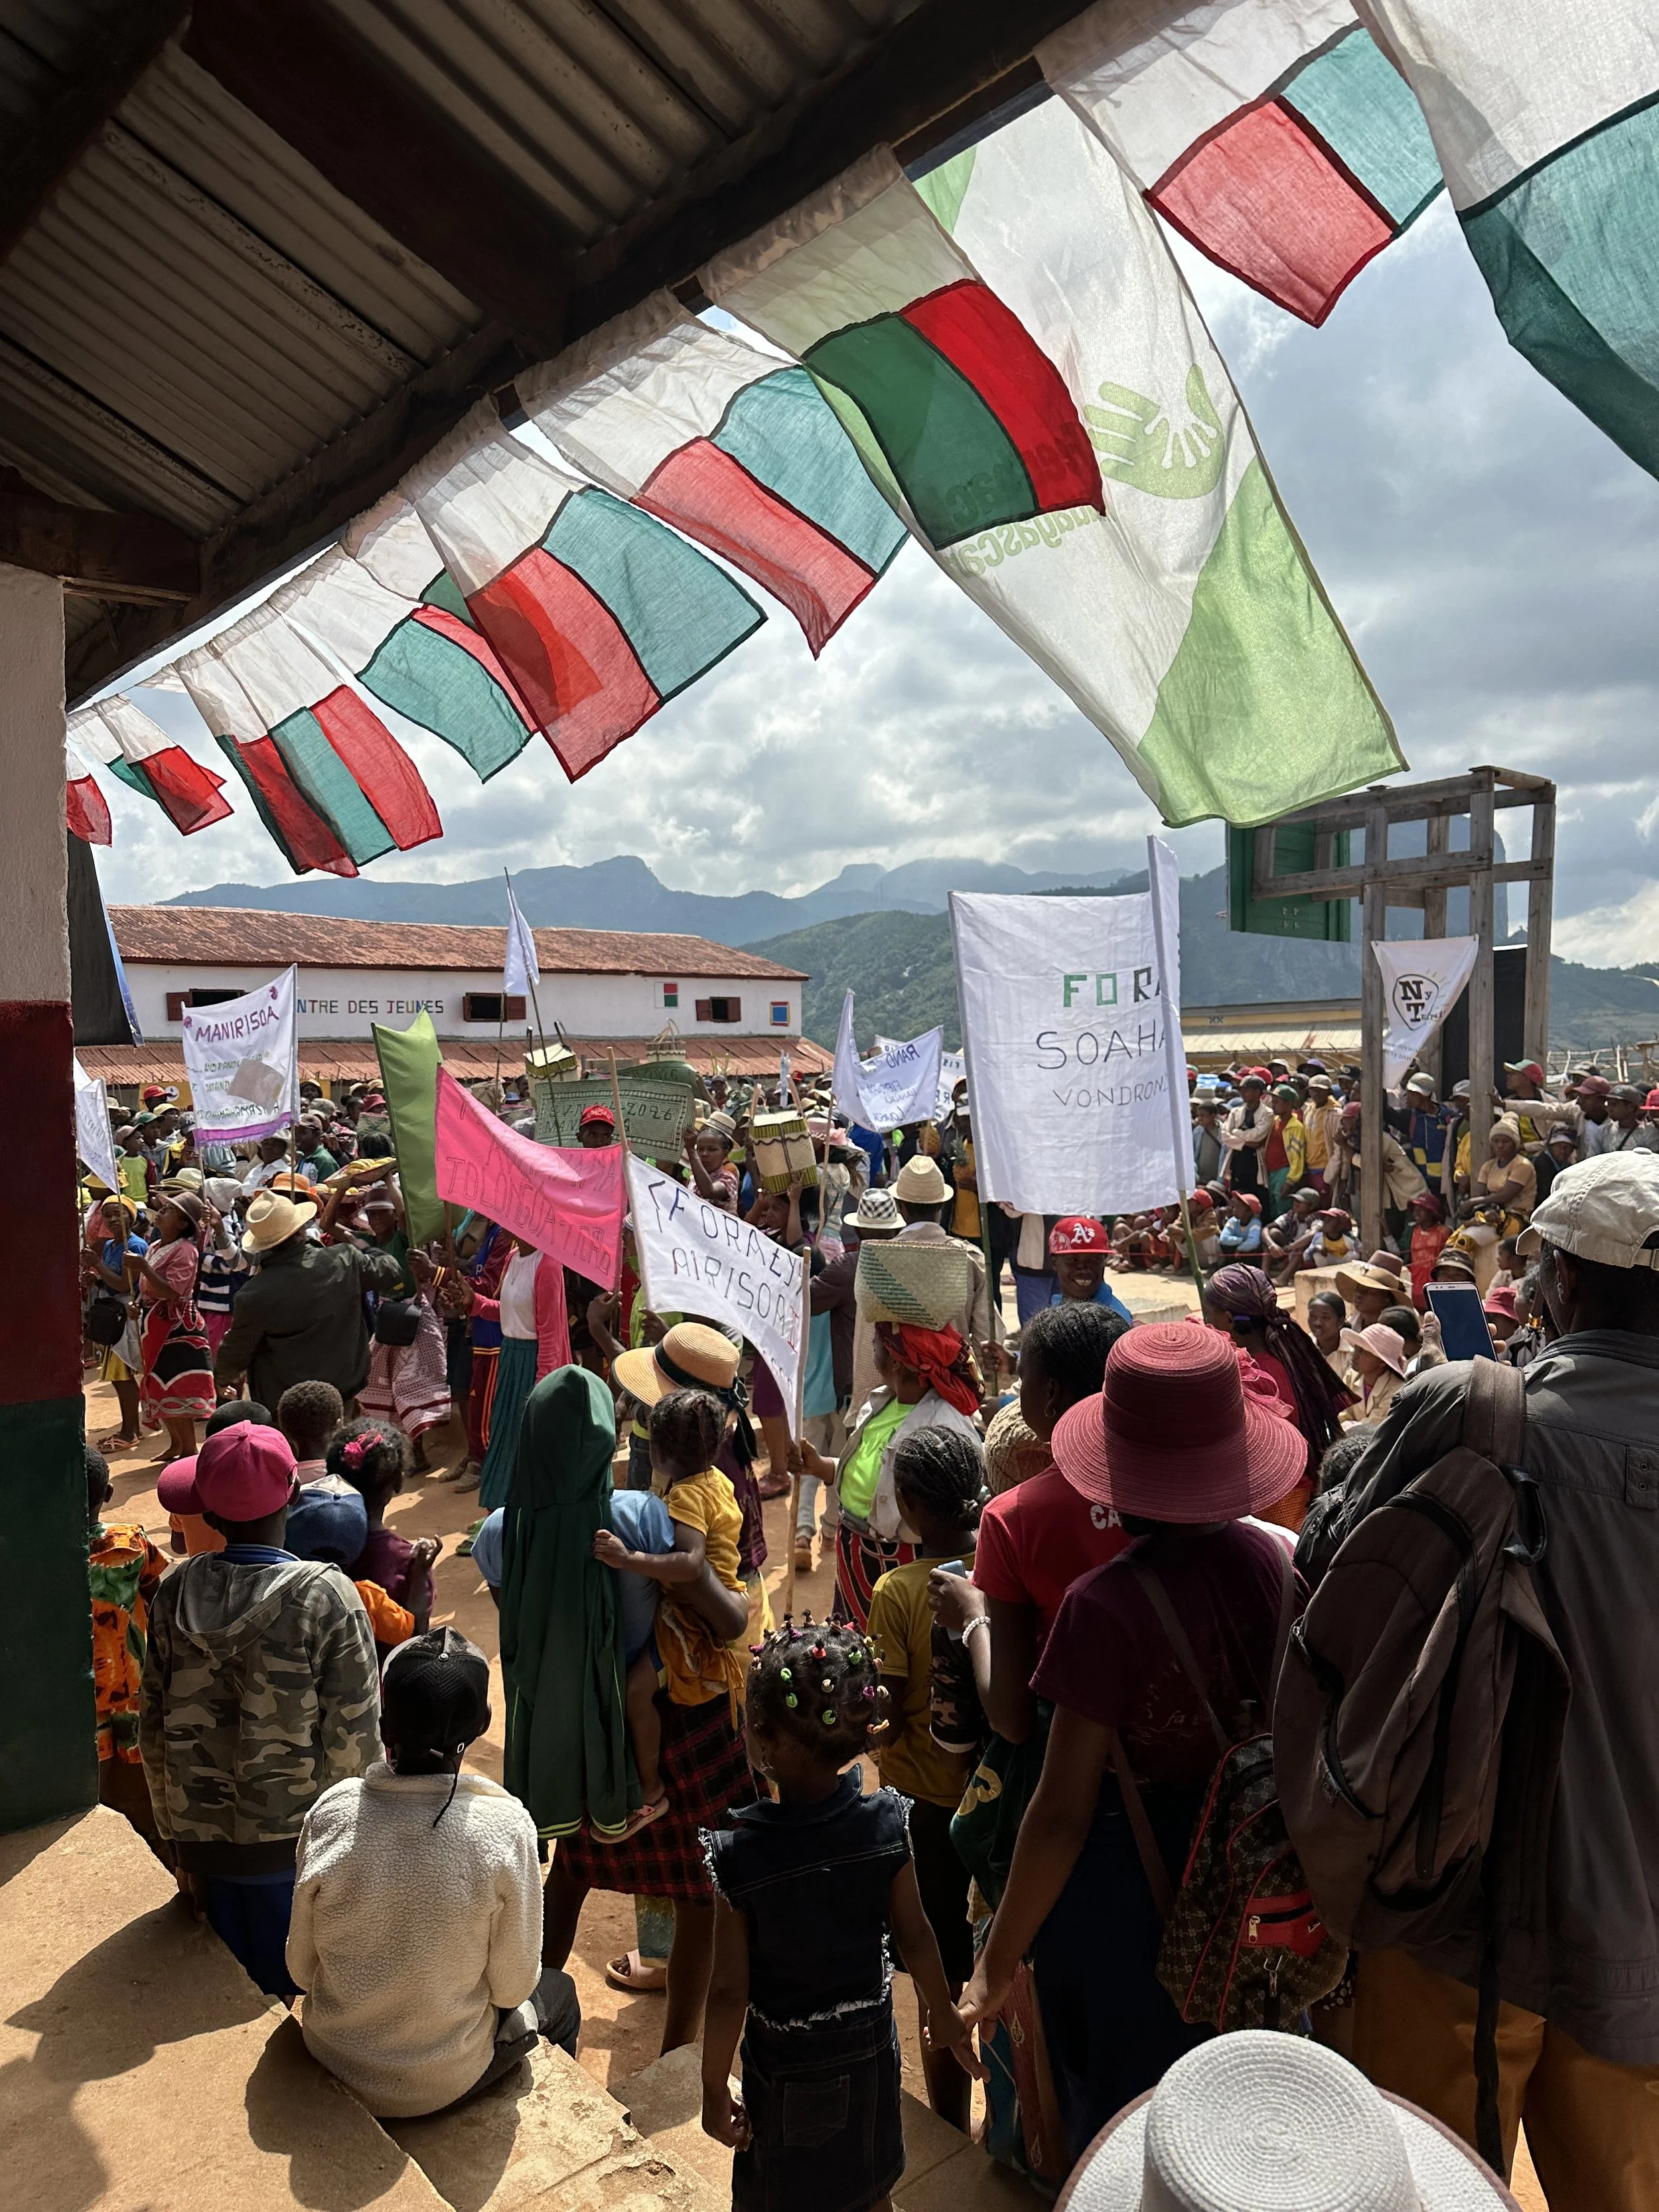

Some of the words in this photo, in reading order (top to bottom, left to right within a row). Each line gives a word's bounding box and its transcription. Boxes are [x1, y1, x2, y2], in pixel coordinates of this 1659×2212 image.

[1063, 967, 1160, 1007] FOR
[195, 1005, 279, 1043] MANIRISOA
[348, 1000, 378, 1013] DES
[387, 1000, 443, 1013] JEUNES
